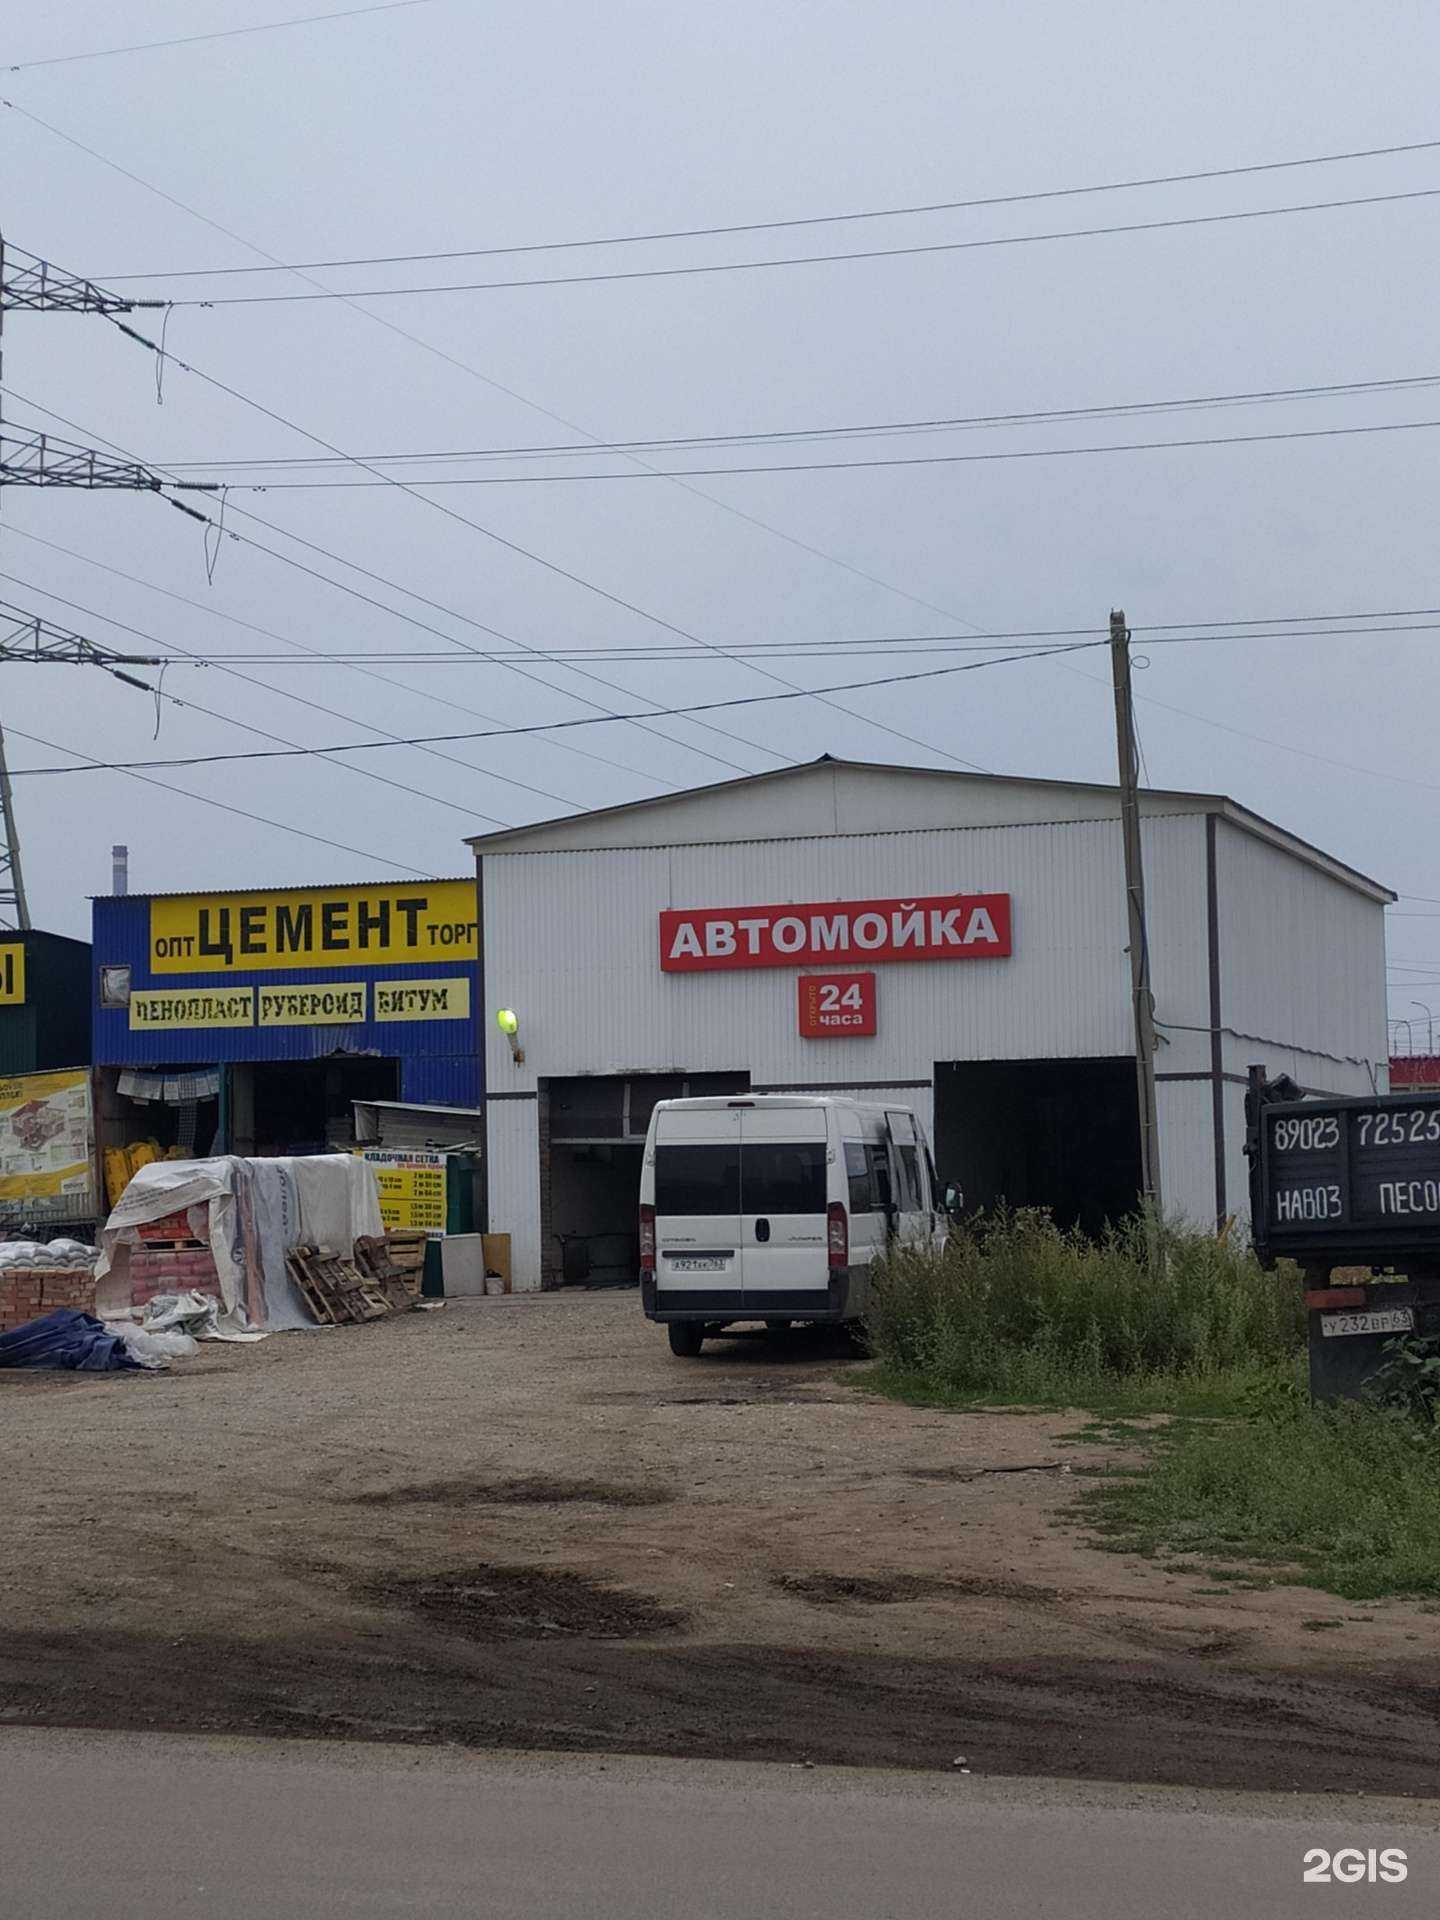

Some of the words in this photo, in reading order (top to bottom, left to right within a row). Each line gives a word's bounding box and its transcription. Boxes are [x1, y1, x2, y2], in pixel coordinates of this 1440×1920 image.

[155, 937, 195, 958] ОПТ
[198, 898, 428, 965] ЦЕМЕНТ
[427, 923, 478, 945] ТОРГ
[669, 903, 999, 959] АВТОМОЙКА
[819, 983, 863, 1011] 24
[820, 1014, 863, 1026] часа
[1275, 1117, 1340, 1150] 89023
[1358, 1110, 1440, 1146] 72525
[1277, 1186, 1342, 1220] НАВОЗ
[1380, 1180, 1440, 1214] ПЕСО
